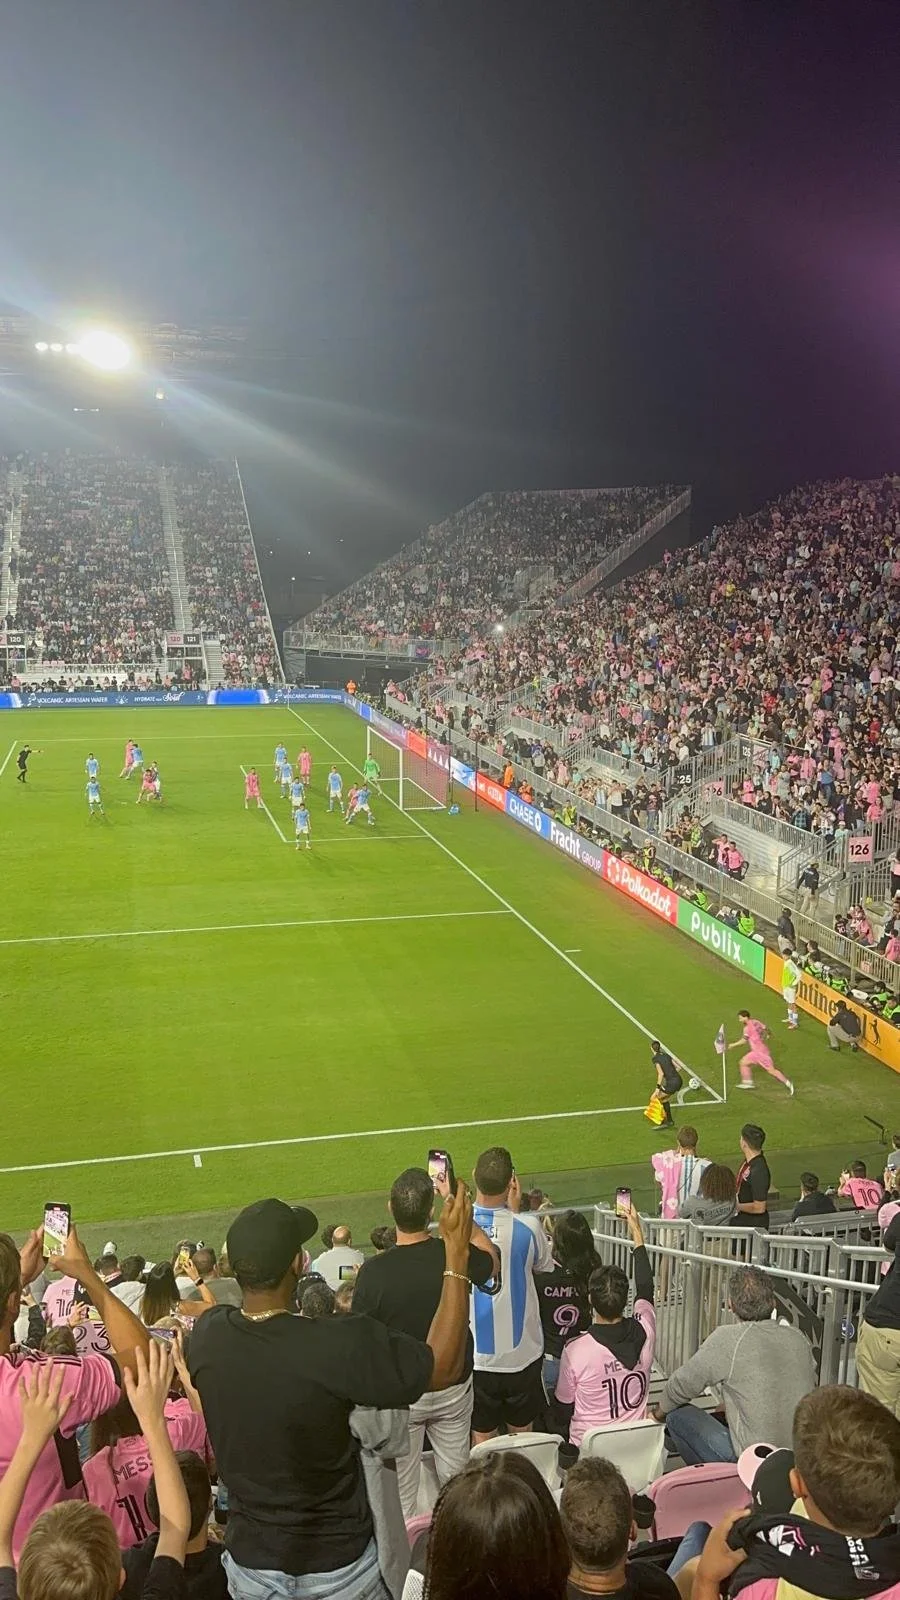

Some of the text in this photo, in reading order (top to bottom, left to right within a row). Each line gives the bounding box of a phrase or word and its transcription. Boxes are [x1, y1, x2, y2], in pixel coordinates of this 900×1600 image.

[509, 798, 534, 826] CHASE
[550, 821, 602, 871] Fracht GROUP
[850, 844, 870, 856] 126
[621, 868, 672, 917] Polkadot
[858, 1188, 881, 1206] 10
[544, 1286, 580, 1298] CAMP
[553, 1303, 580, 1336] 9
[74, 1323, 111, 1353] 23
[601, 1370, 647, 1419] 10
[112, 1454, 153, 1485] MES
